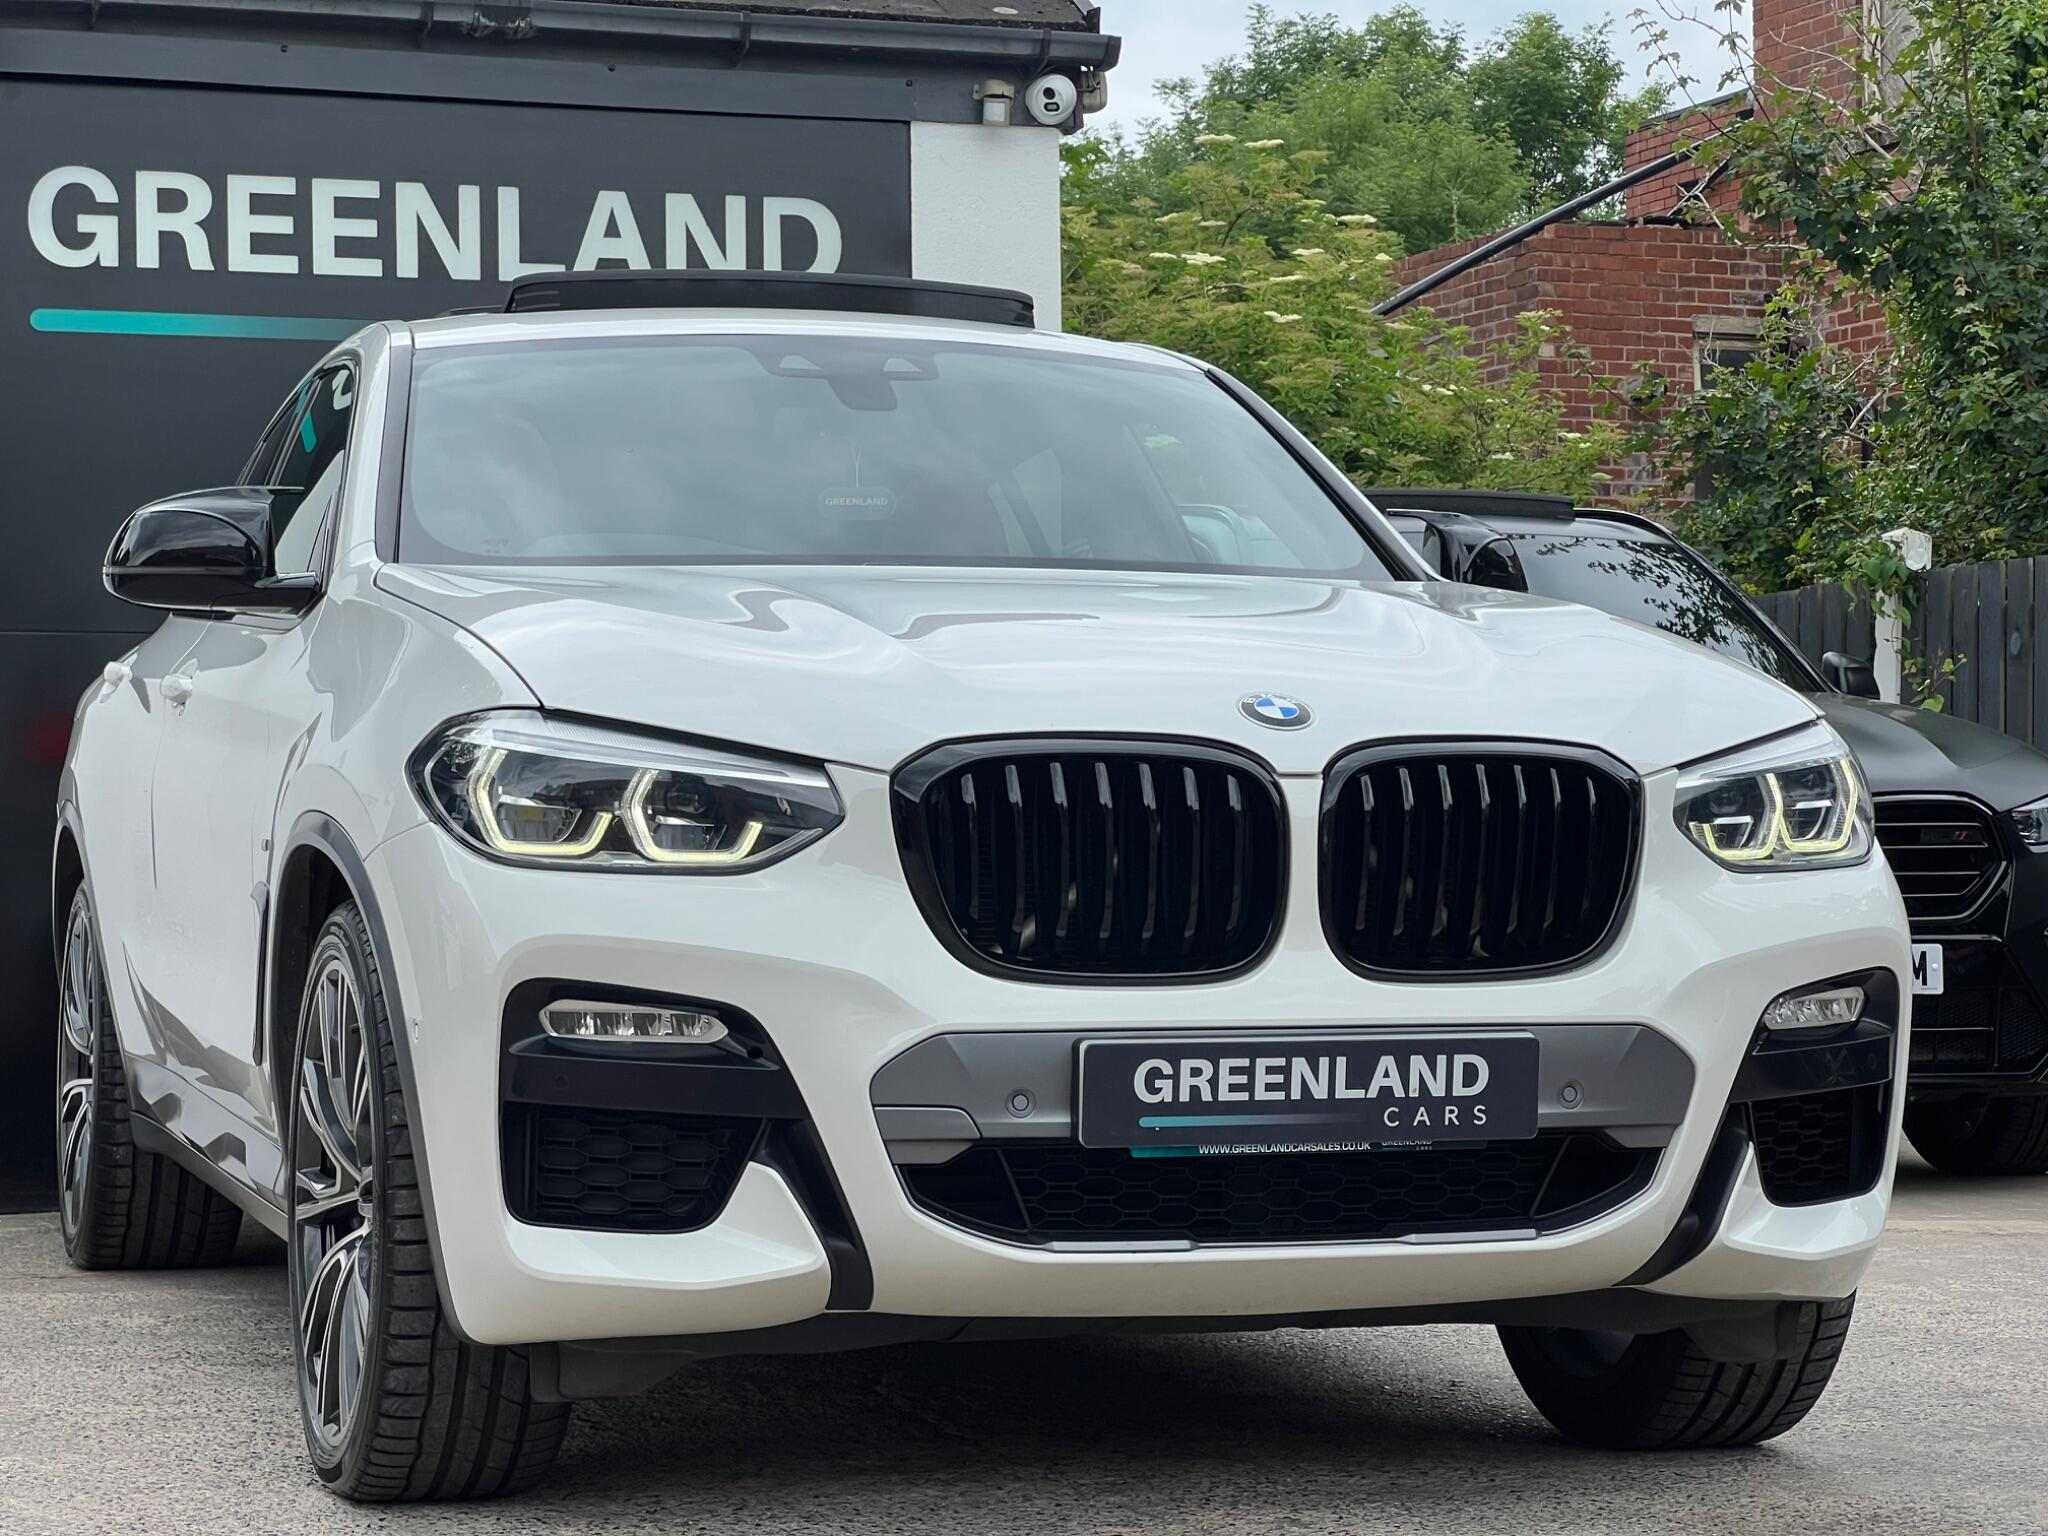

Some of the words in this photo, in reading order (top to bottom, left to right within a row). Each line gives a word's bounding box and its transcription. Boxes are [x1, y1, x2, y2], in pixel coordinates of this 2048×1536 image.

[27, 165, 843, 281] GREENLAND
[825, 497, 888, 505] GREENLAND
[1133, 1054, 1490, 1104] GREENLAND
[1383, 1105, 1487, 1127] CARS
[1199, 1142, 1371, 1154] WWW.GREENLANDCARSALES.CO.UK
